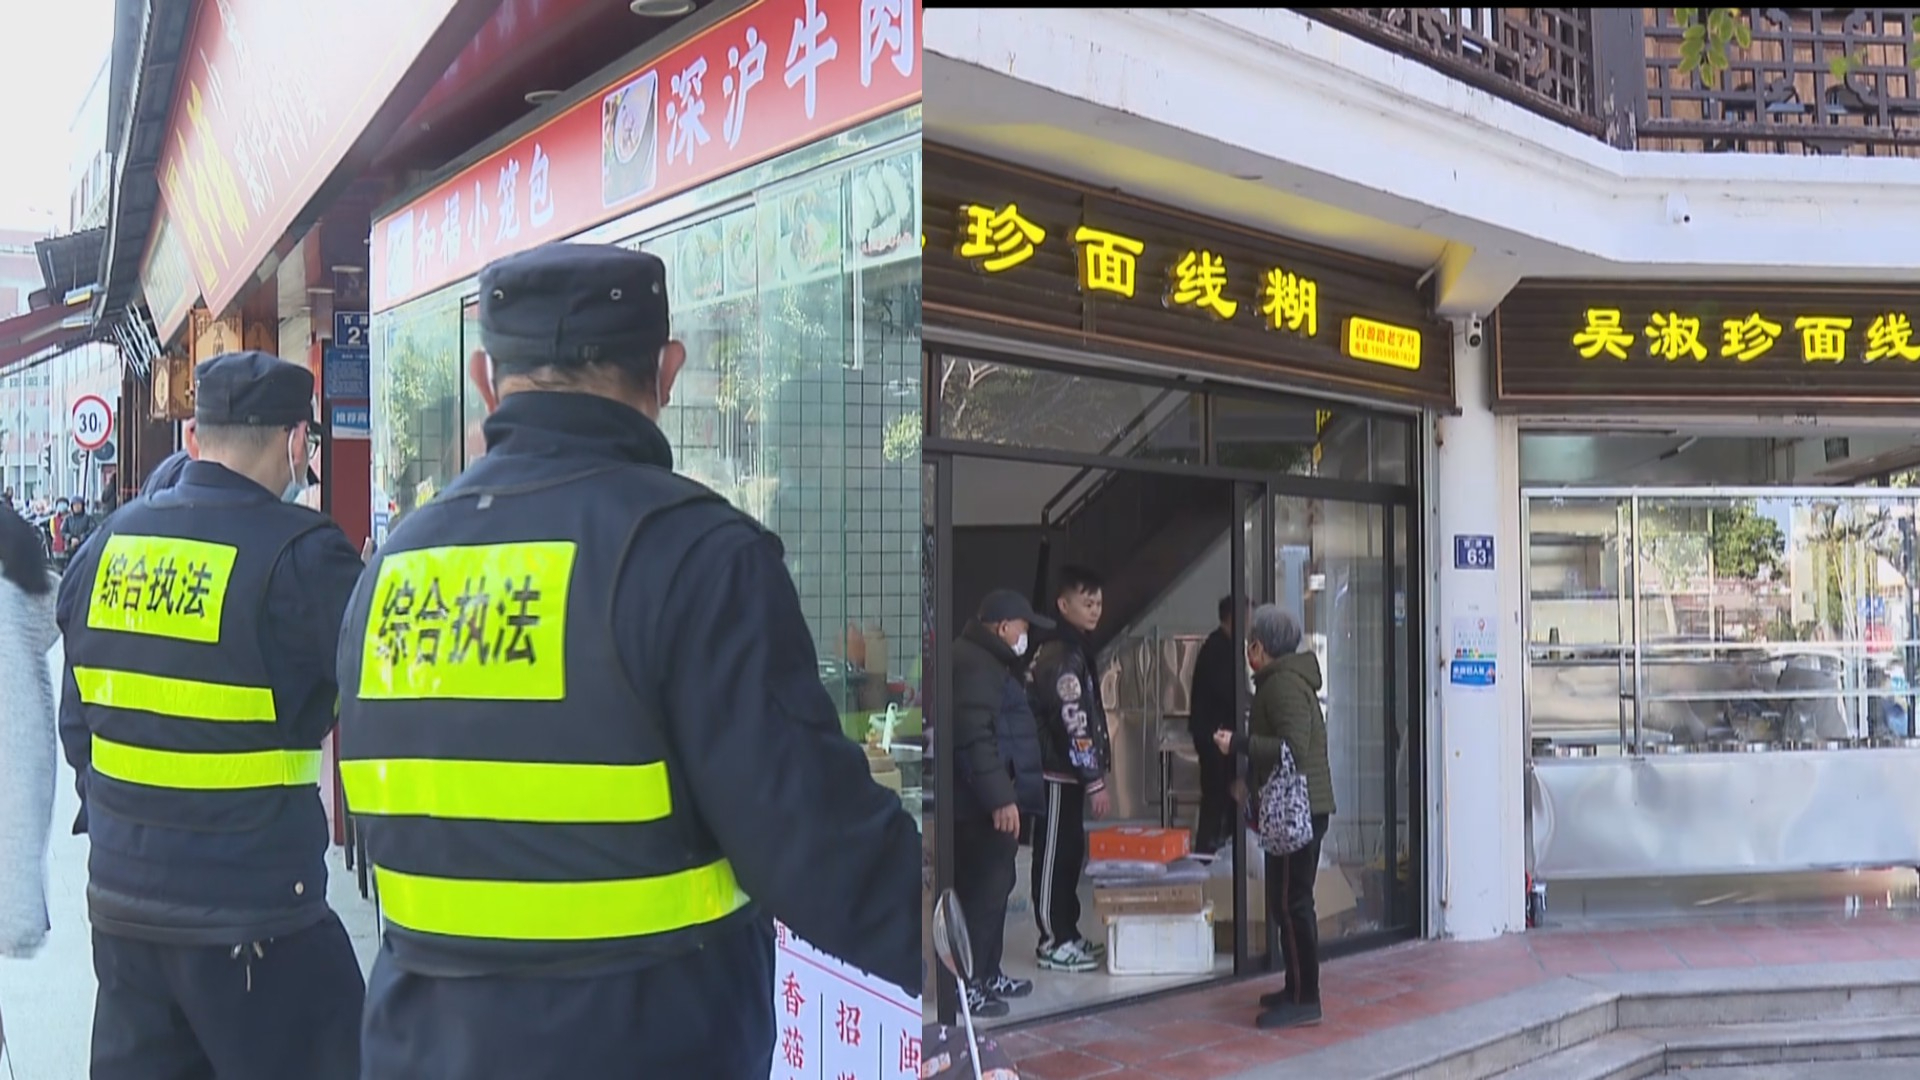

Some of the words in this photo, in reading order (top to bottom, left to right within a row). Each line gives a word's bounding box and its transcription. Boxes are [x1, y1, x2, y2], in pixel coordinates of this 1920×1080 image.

[666, 0, 914, 166] 深沪牛肉
[416, 142, 554, 281] 和福小笼包
[922, 203, 1318, 337] 珍面线糊
[1573, 308, 1920, 361] 吴淑珍面线
[100, 553, 213, 619] 综合执法
[376, 575, 541, 666] 综合执法
[782, 971, 805, 1080] 香菇
